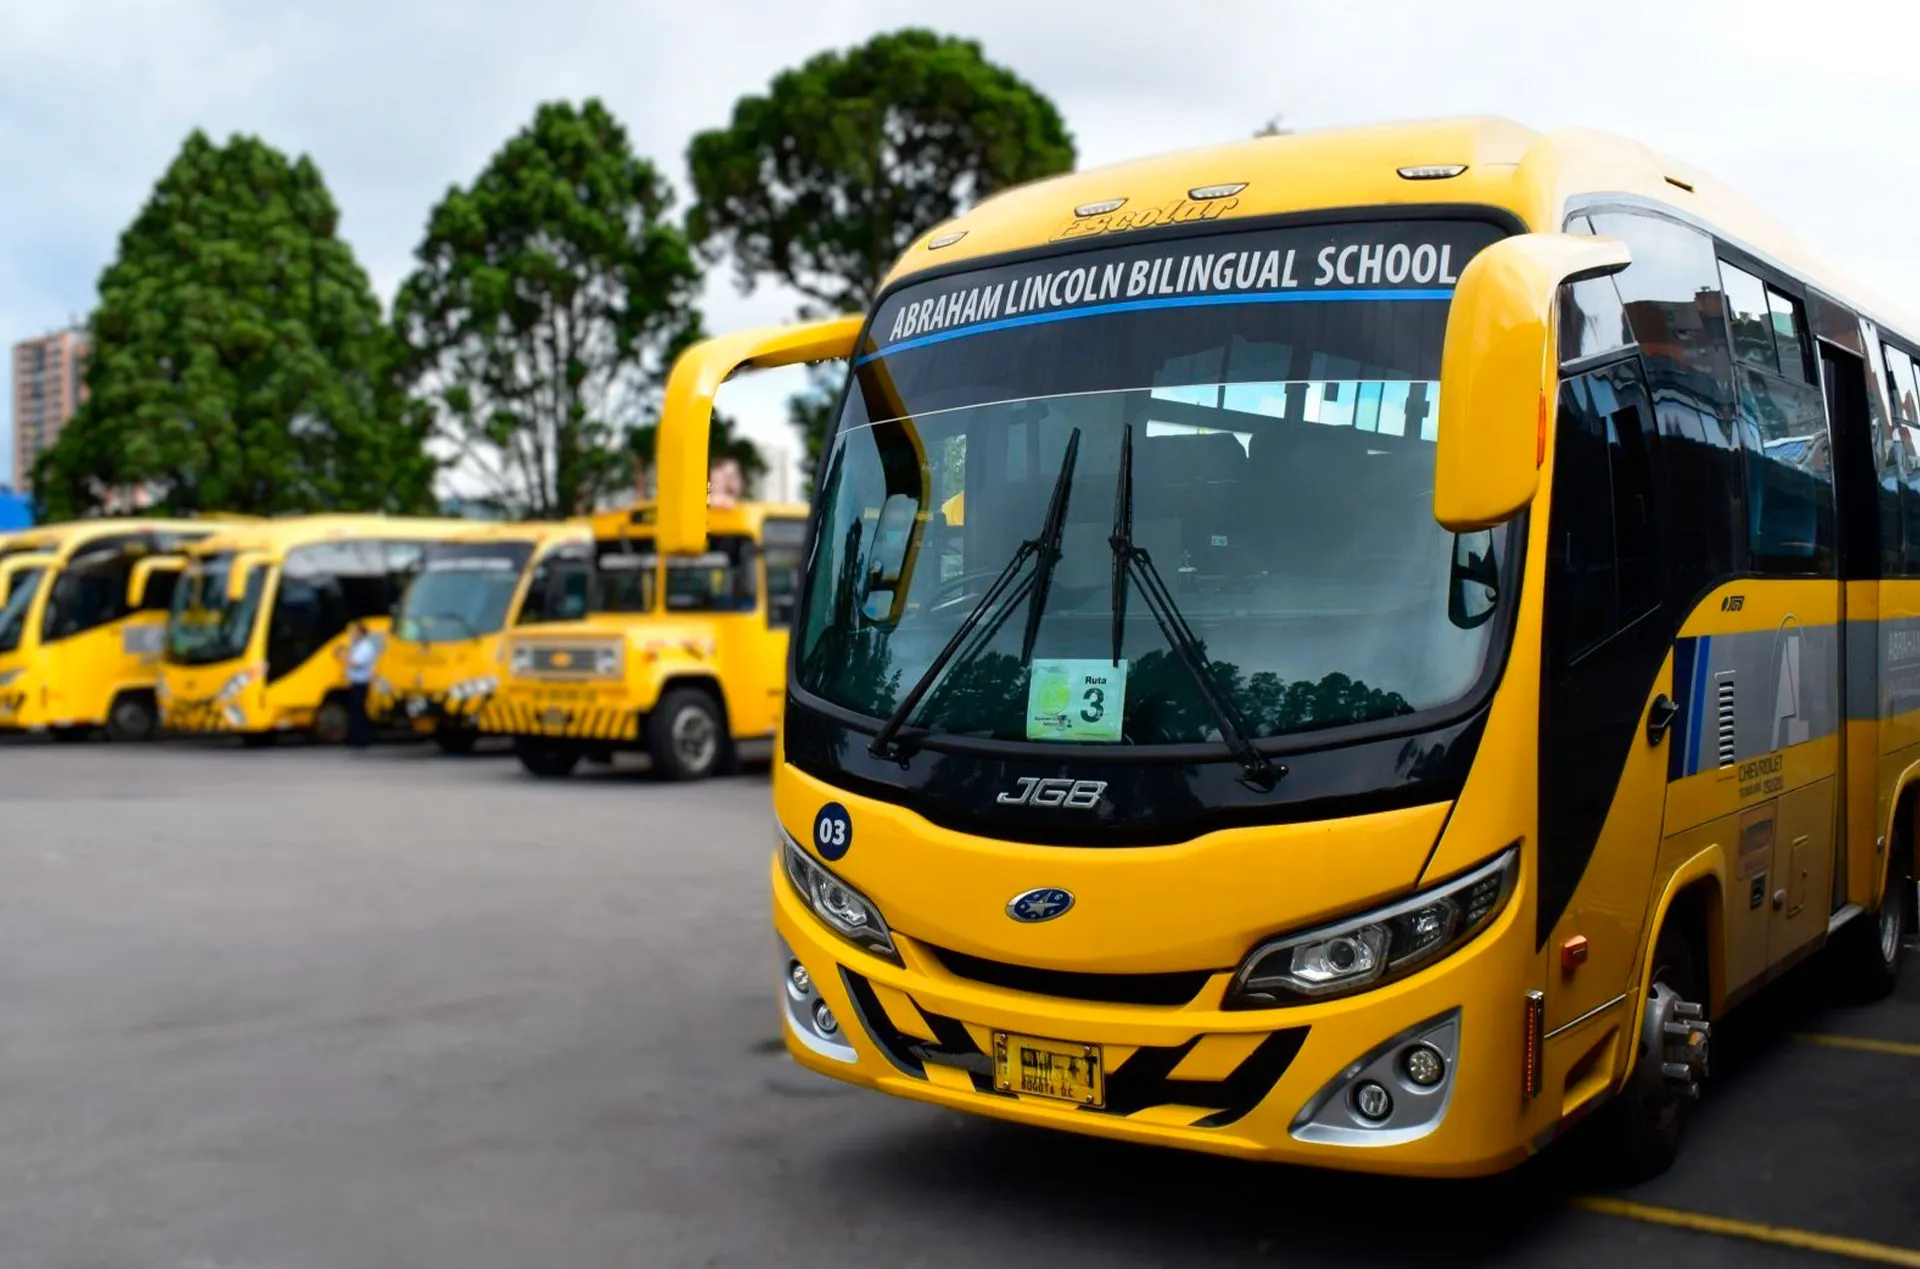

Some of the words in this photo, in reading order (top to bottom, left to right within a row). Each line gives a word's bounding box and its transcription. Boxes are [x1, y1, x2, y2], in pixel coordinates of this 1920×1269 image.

[1049, 197, 1239, 243] Escolar
[889, 283, 1004, 342] ABRAHAM
[1005, 262, 1125, 315] LINCOLN
[1127, 249, 1298, 297] BILINGUAL
[1314, 243, 1457, 286] SCHOOL
[1085, 676, 1107, 685] Ruta
[1080, 688, 1105, 723] 3
[997, 777, 1108, 809] JGB
[819, 817, 846, 846] 03
